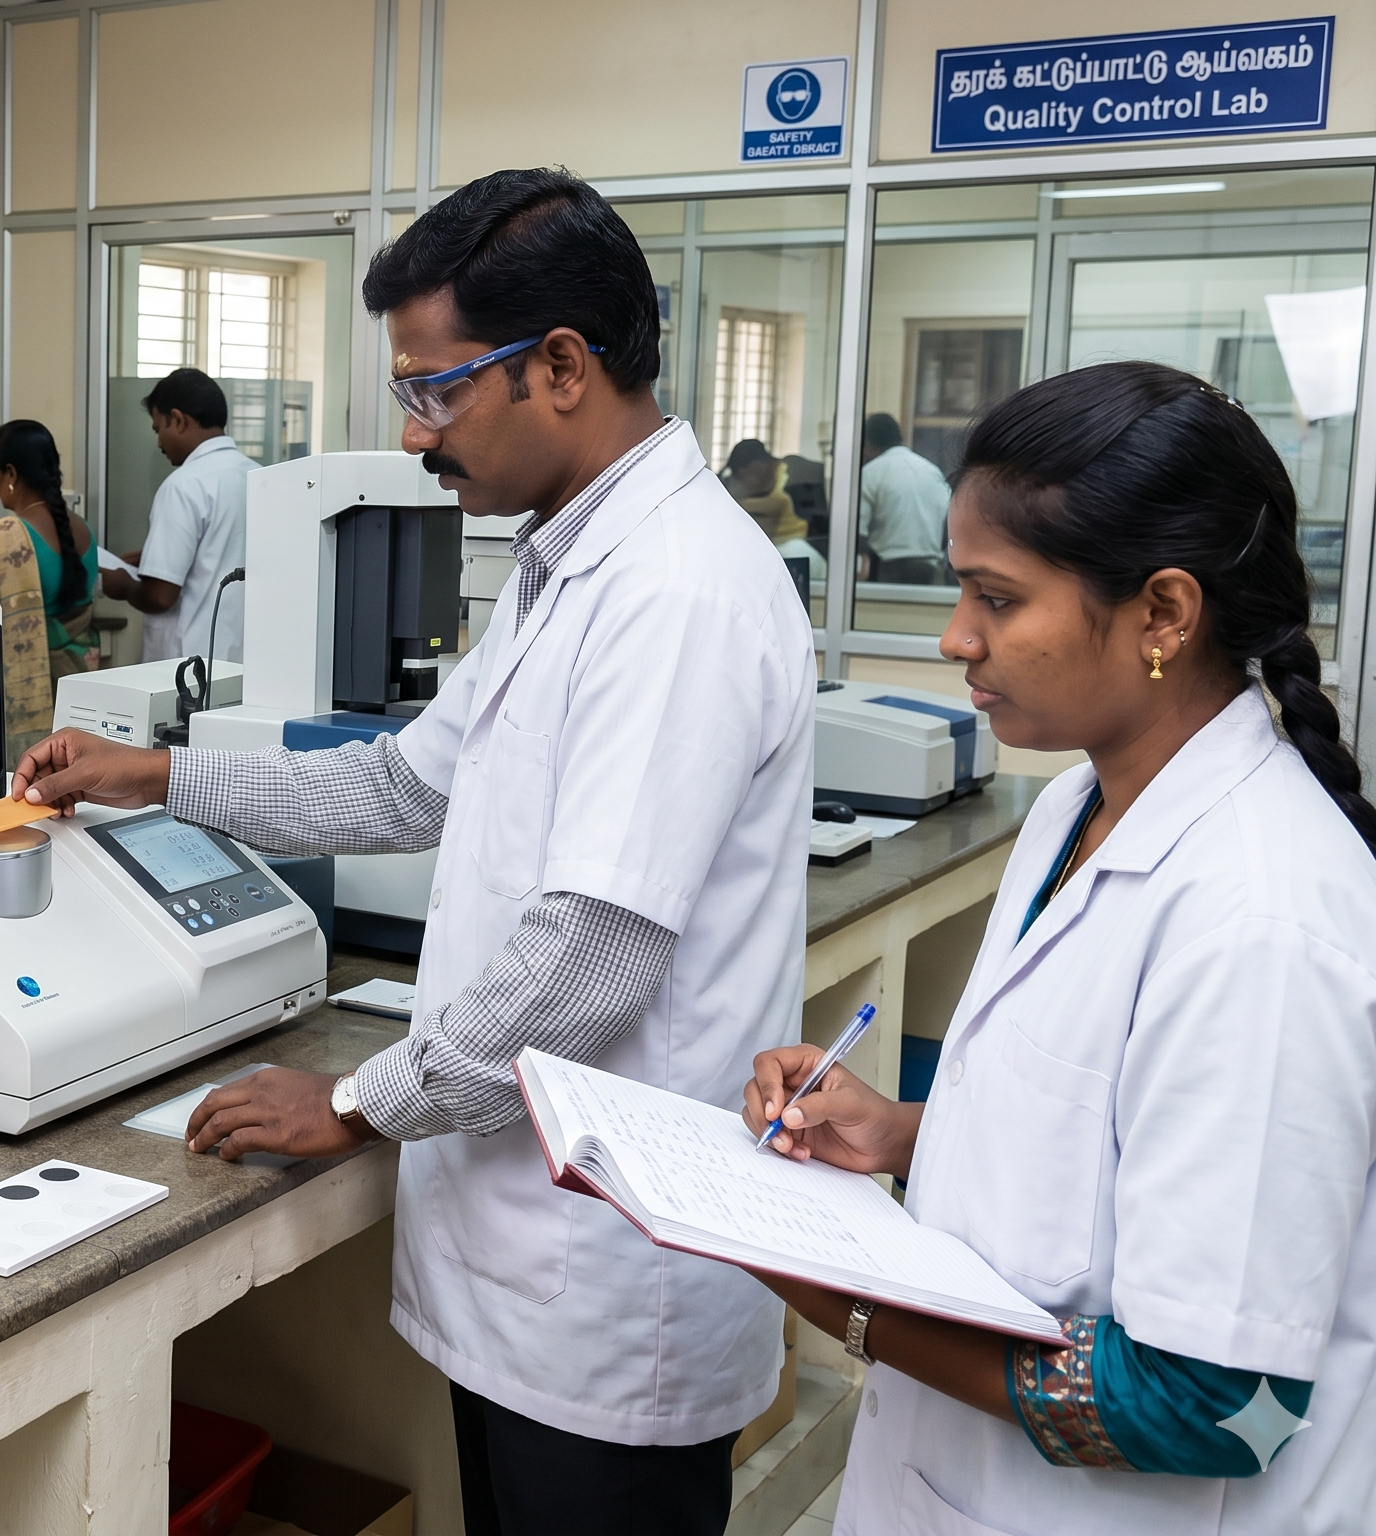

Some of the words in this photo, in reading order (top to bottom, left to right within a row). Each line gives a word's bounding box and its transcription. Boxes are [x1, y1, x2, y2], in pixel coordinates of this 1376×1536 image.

[948, 59, 1008, 102] தரக்
[1012, 50, 1168, 92] கட்டுப்பாட்டு
[1174, 34, 1314, 82] ஆய்வகம்
[983, 103, 1084, 133] Quality
[1092, 91, 1201, 125] Control
[1211, 86, 1269, 117] Lab
[769, 130, 814, 144] SAFETY
